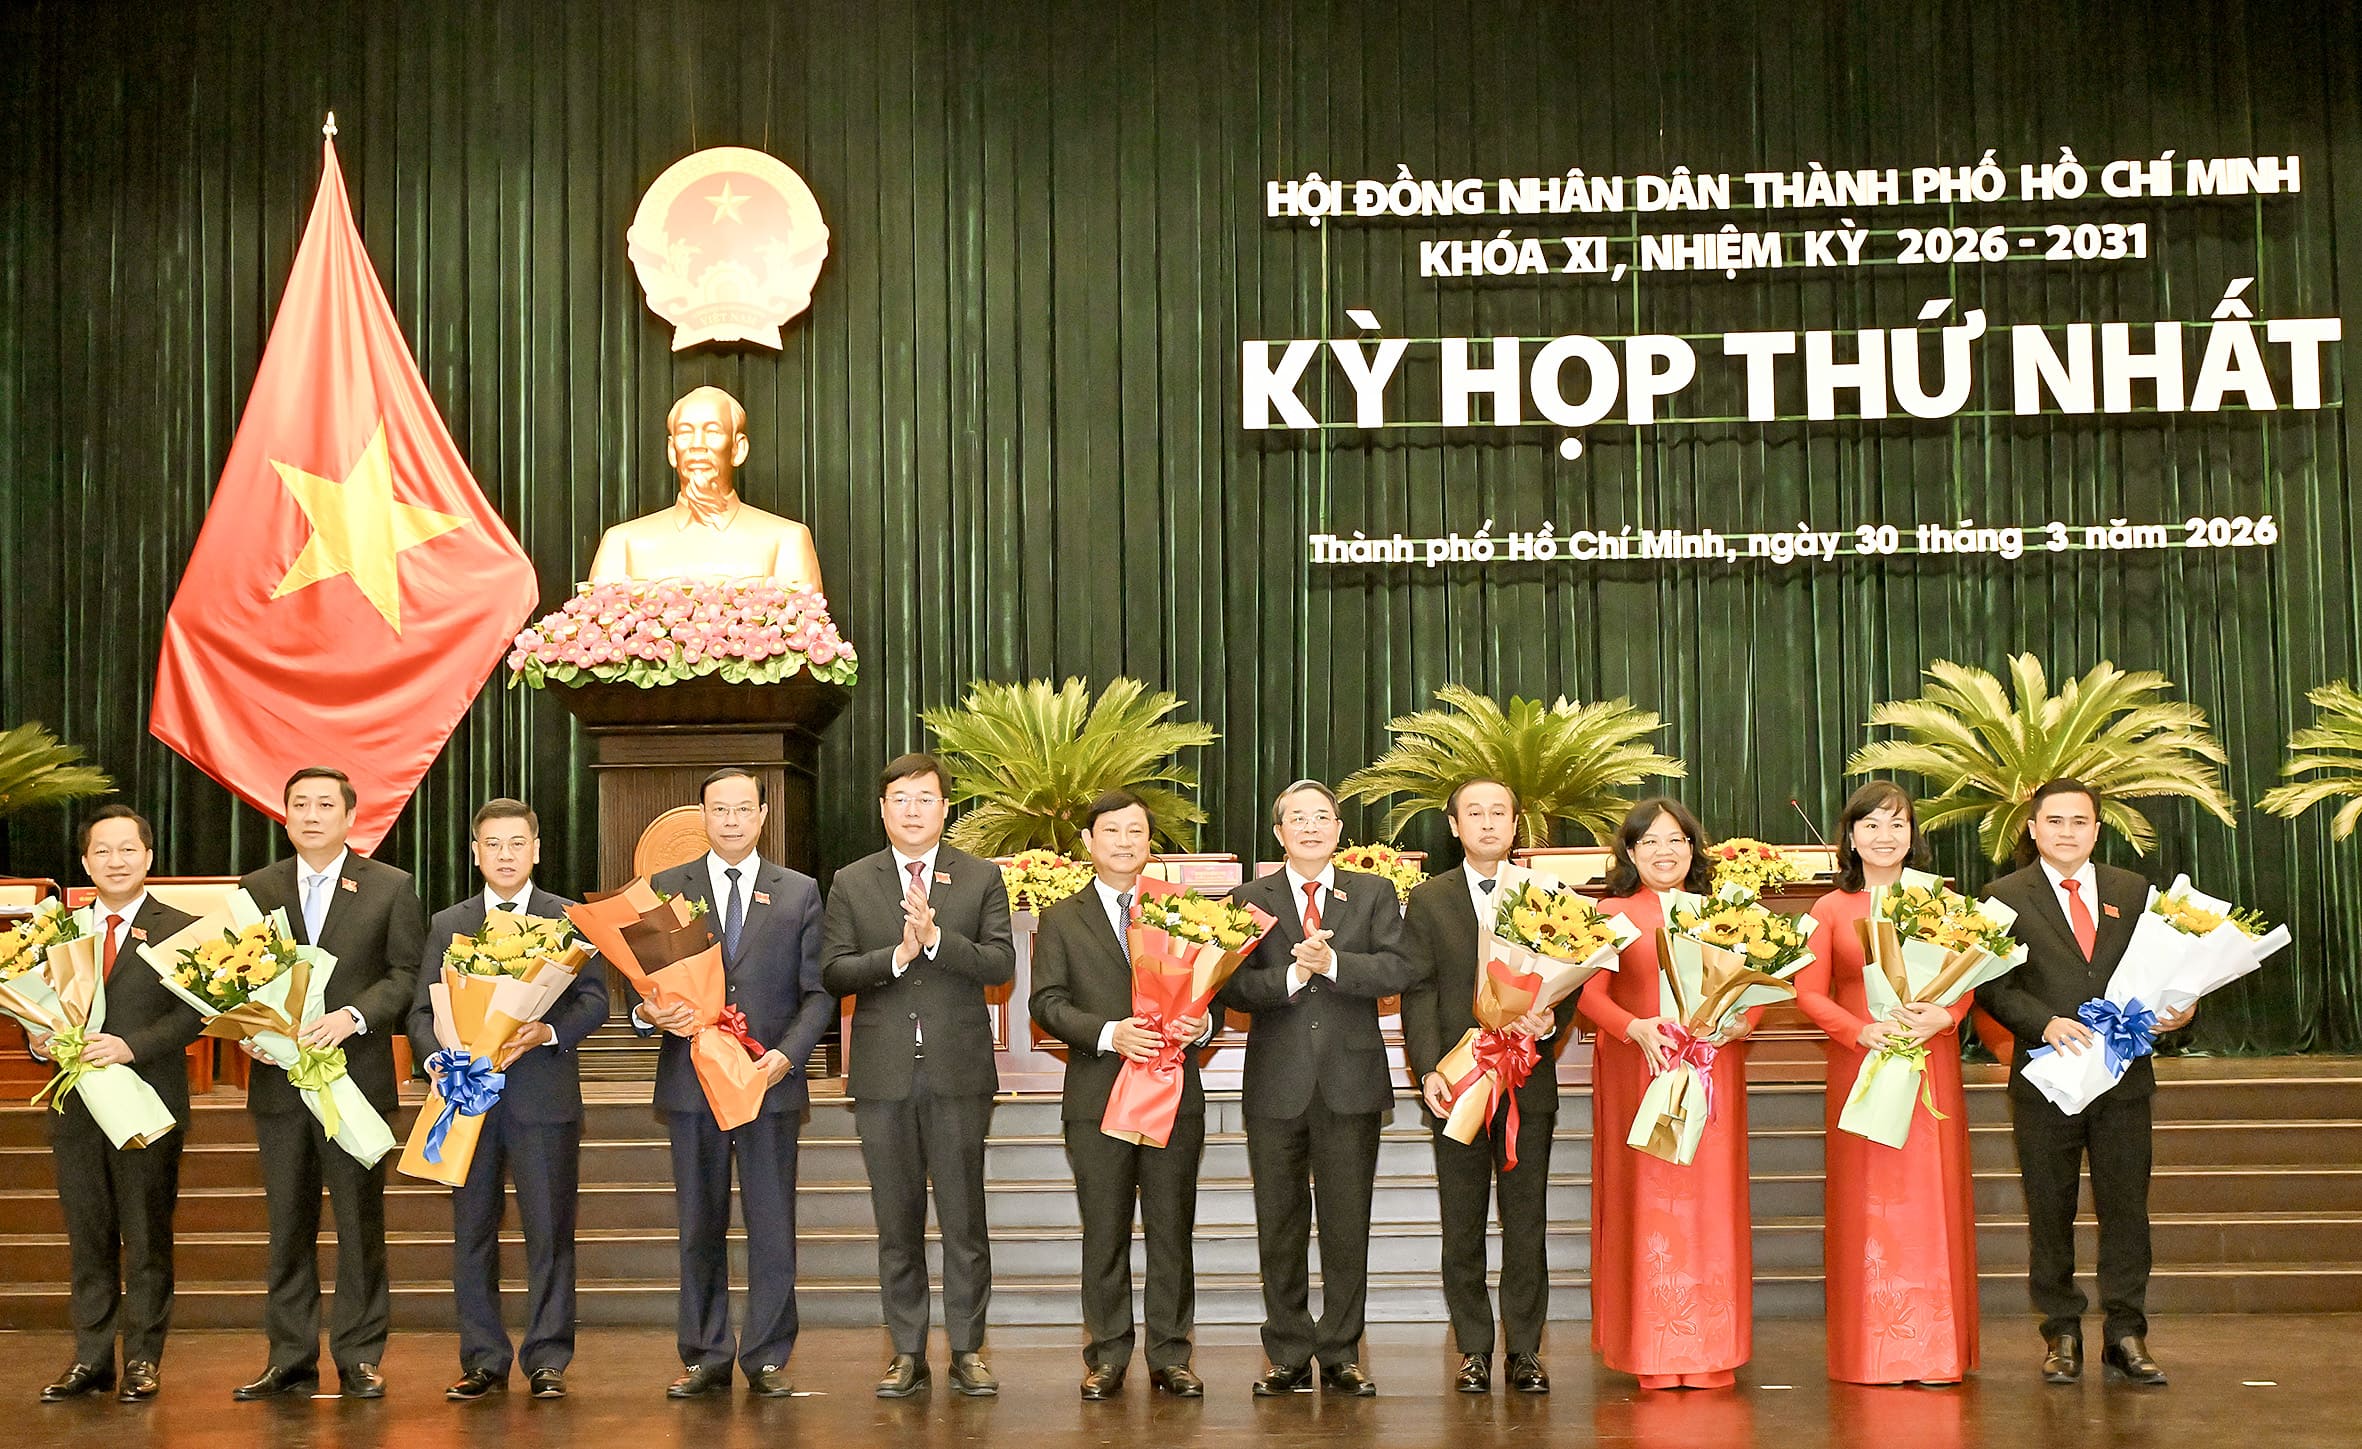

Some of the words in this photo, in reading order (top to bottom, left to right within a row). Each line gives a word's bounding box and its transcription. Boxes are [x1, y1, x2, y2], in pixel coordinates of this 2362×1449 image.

[1267, 172, 1342, 227] HỘI
[1353, 163, 1485, 217] ĐỒNG
[1499, 167, 1624, 215] NHÂN
[1637, 165, 1730, 212] DÂN
[1744, 161, 1899, 209] THÀNH
[1912, 149, 2007, 204] PHỐ
[2020, 146, 2088, 201] HỒ
[2101, 149, 2176, 198] CHÍ
[2186, 155, 2301, 196] MINH
[1420, 229, 1549, 277] KHÓA
[1561, 236, 1628, 282] XI,
[1640, 223, 1783, 280] NHIỆM
[1804, 218, 1869, 267] KỲ
[1896, 225, 2009, 264] 2026
[2019, 238, 2036, 248] -
[2045, 222, 2148, 261] 2031
[1242, 309, 1411, 430] KỲ
[1441, 334, 1697, 460] HỌP
[1723, 298, 1988, 422] THỨ
[2012, 277, 2343, 416] NHẤT
[1309, 530, 1415, 563] Thành
[1426, 518, 1496, 568] phố
[1508, 520, 1558, 561] Hồ
[1568, 524, 1633, 560] Chí
[1640, 528, 1738, 564] Minh,
[1747, 522, 1841, 566] ngày
[1854, 525, 1899, 556] 30
[1915, 519, 2023, 560] tháng
[2042, 521, 2069, 553] 3
[2085, 518, 2168, 550] năm
[2184, 515, 2278, 548] 2026
